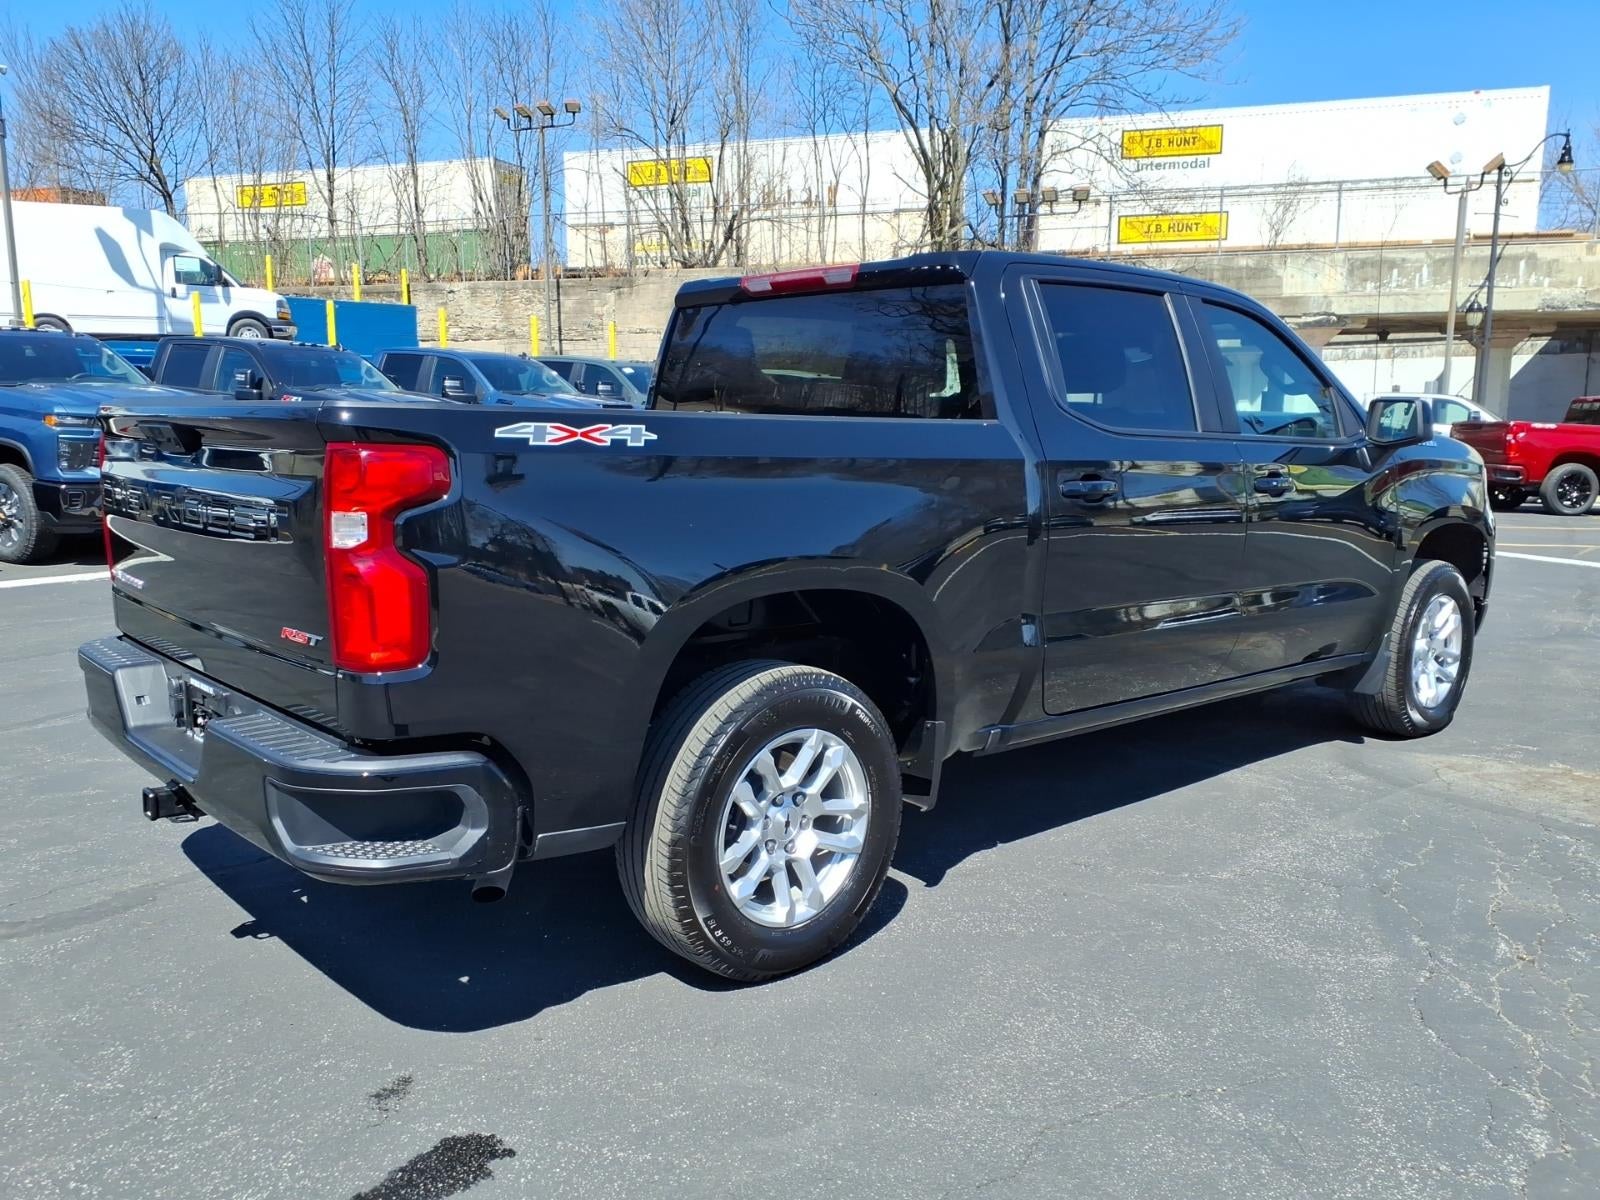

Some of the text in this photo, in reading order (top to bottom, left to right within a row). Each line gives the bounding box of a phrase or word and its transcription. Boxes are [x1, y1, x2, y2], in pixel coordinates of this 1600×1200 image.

[1168, 136, 1199, 148] HUNT
[1137, 157, 1211, 172] Intermodal
[1168, 222, 1201, 233] HUNT
[494, 422, 658, 447] 4X4
[280, 626, 324, 647] RST
